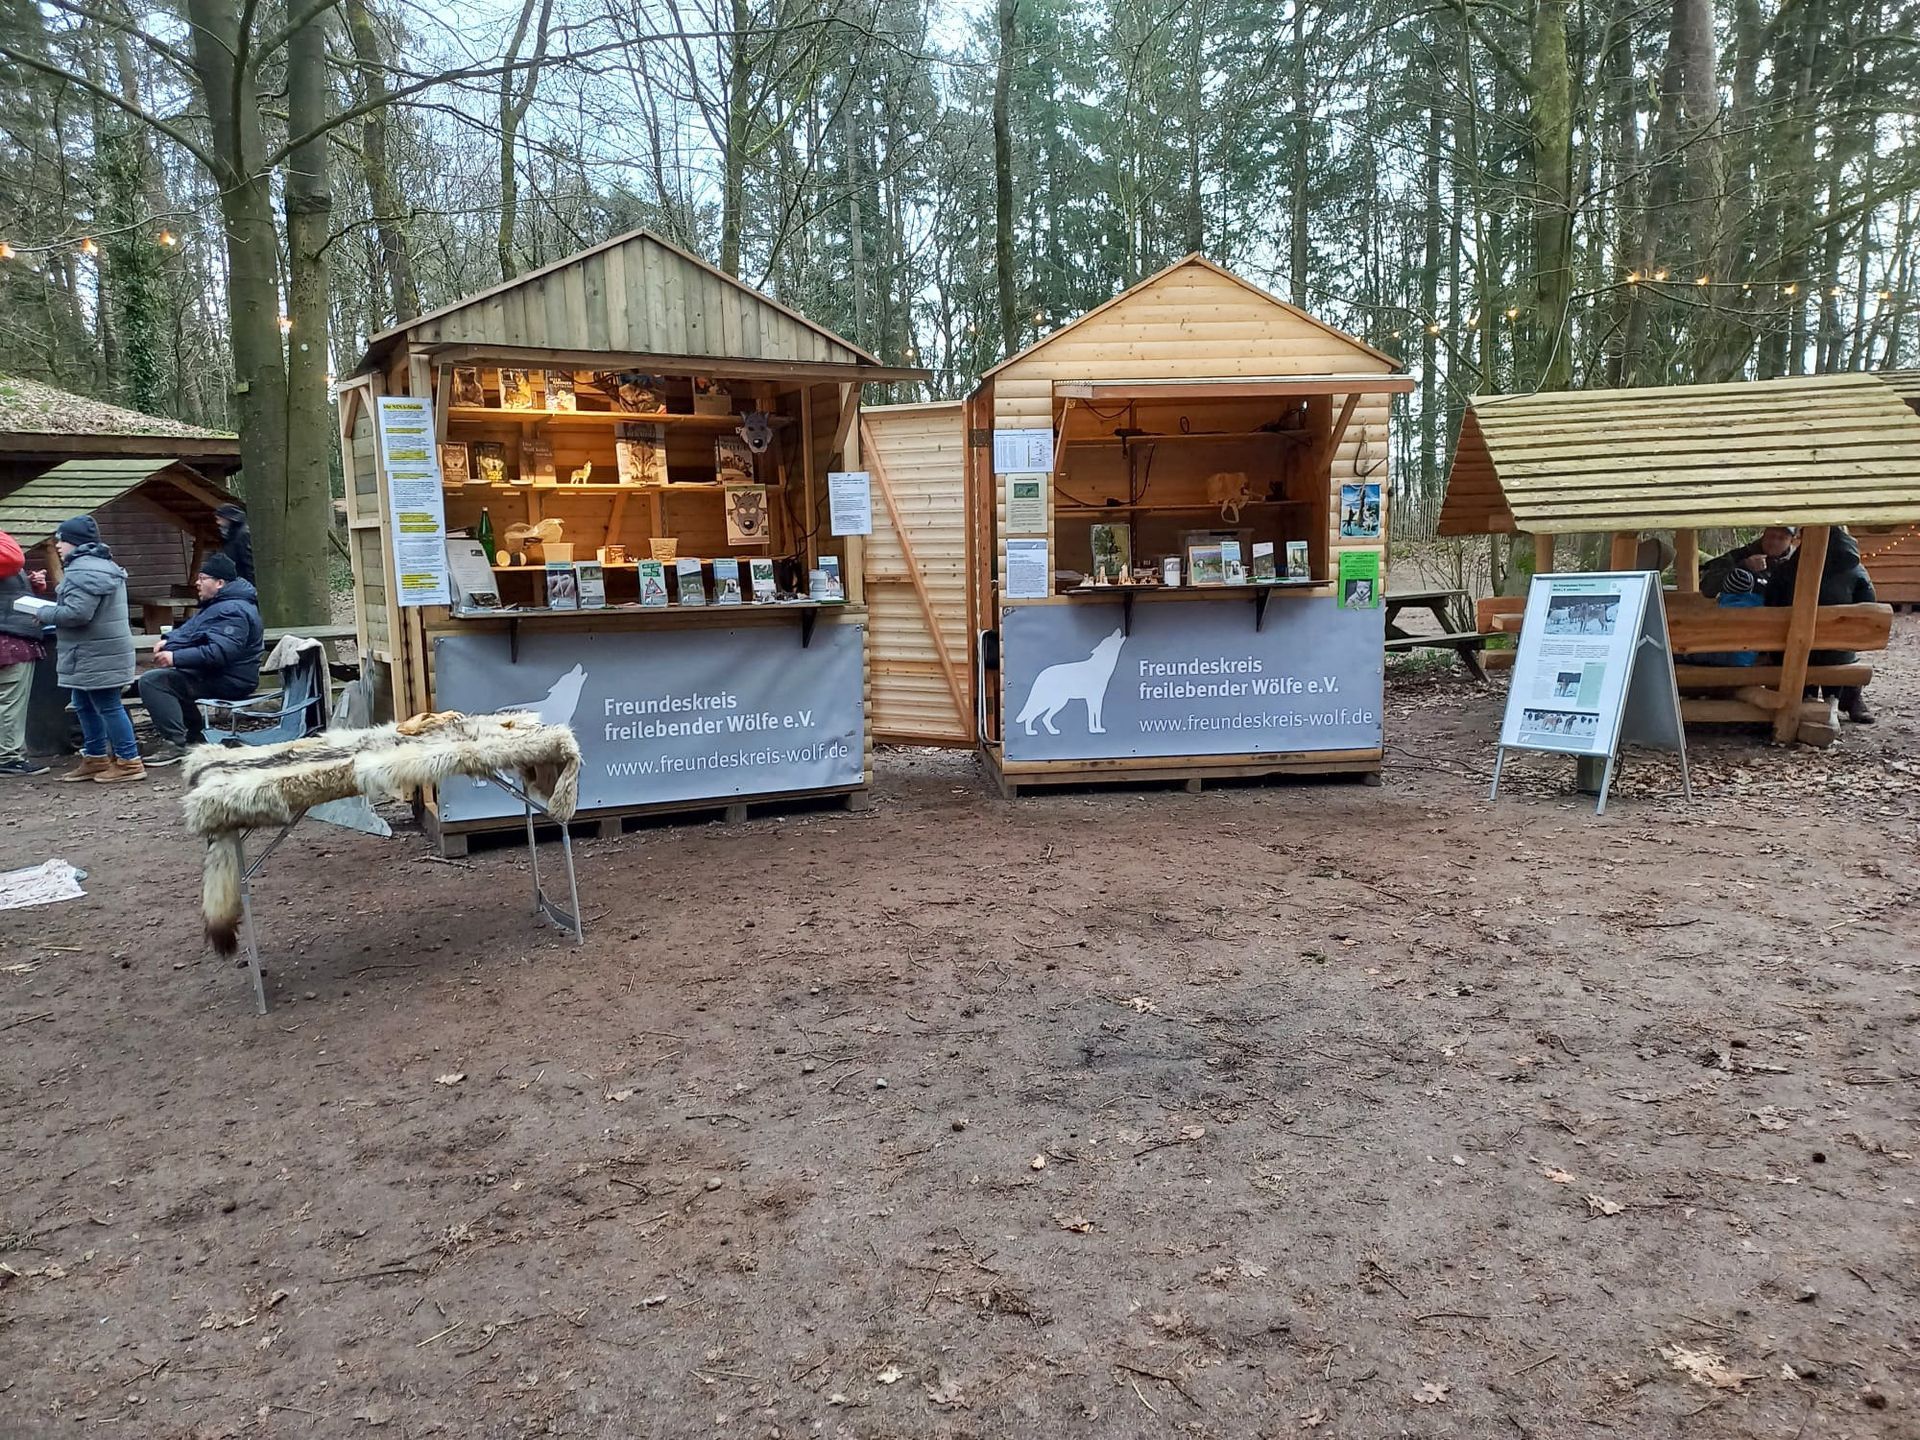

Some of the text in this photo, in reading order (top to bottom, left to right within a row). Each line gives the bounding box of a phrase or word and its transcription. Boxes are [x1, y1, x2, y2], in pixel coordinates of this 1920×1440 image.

[1139, 656, 1263, 677] Freundeskreis
[1139, 676, 1339, 700] freilebender Wölfe e.V.
[604, 691, 737, 716] Freundeskreis
[604, 710, 815, 741] freilebender Wölfe e.V.
[1139, 707, 1373, 732] www.freundeskreis-wolf.de
[606, 741, 848, 777] www.freundeskreis-wolf.de
